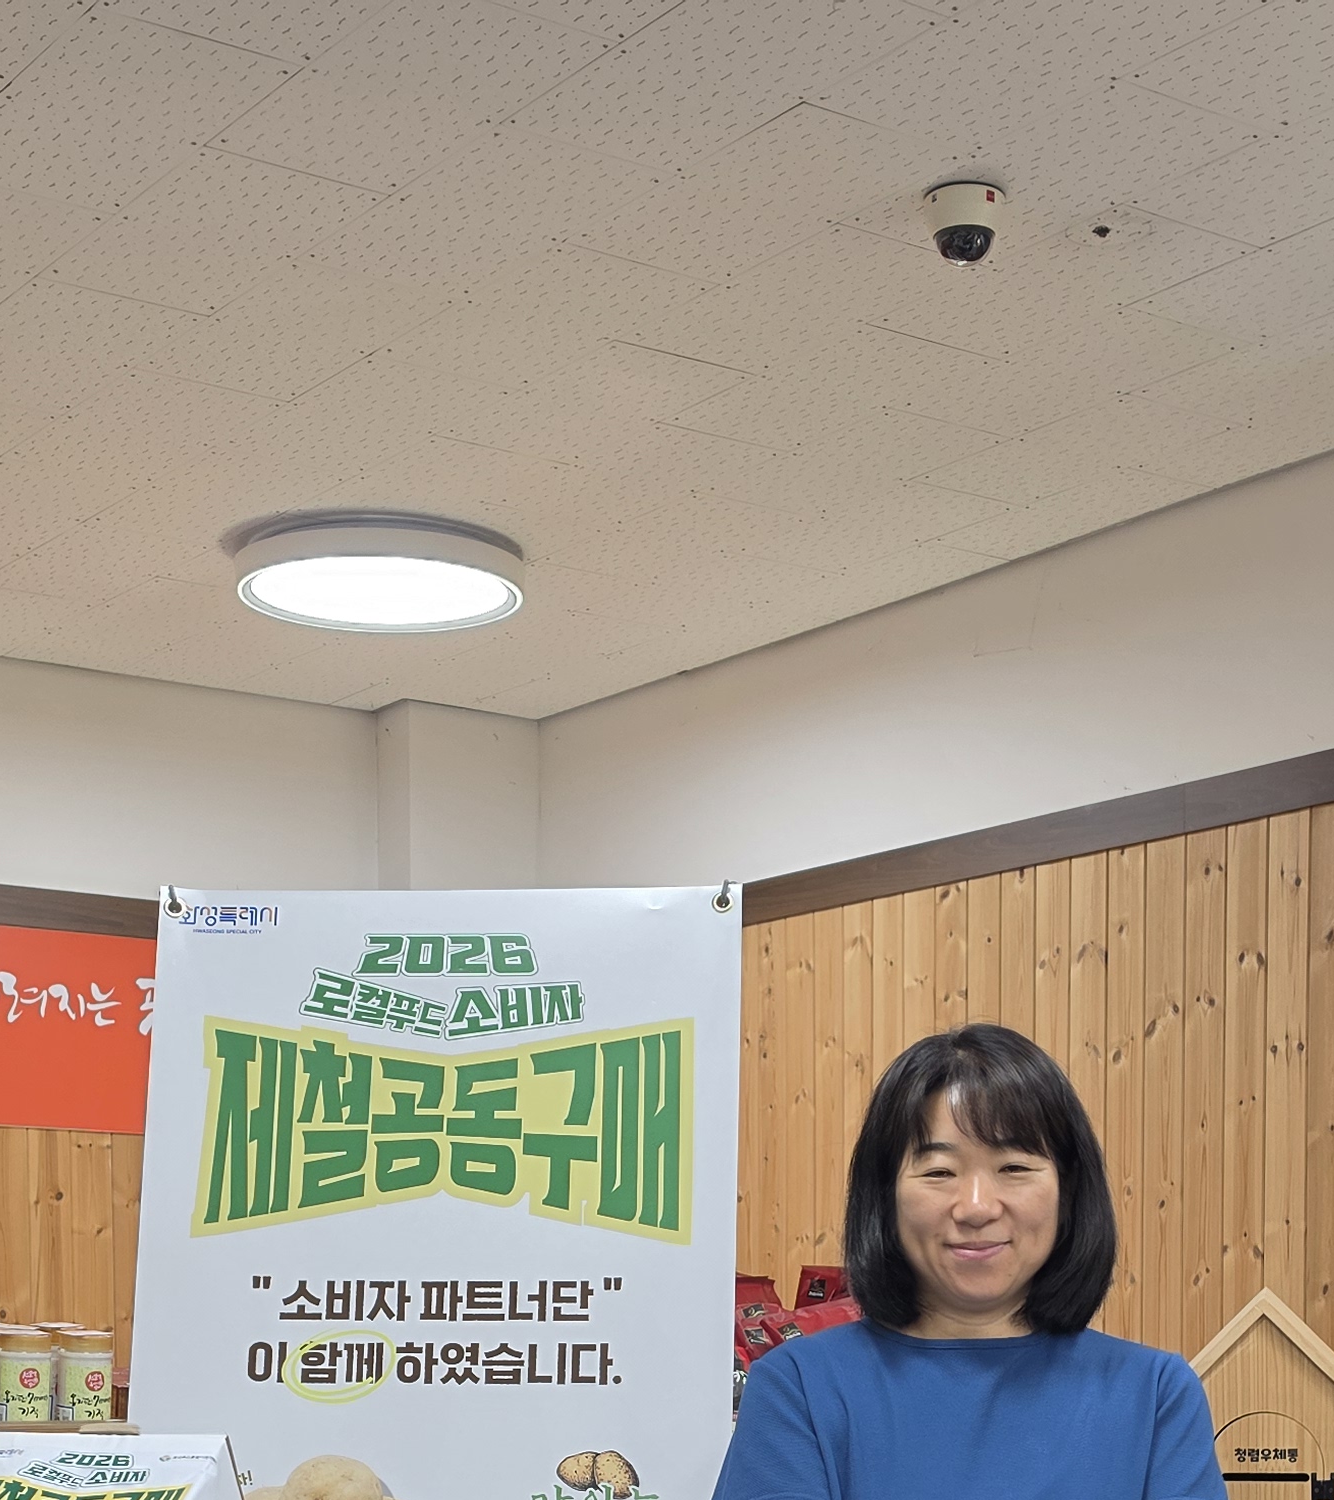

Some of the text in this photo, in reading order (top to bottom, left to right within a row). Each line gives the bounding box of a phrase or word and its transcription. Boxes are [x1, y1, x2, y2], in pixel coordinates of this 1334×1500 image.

[361, 935, 536, 974] 2026
[305, 970, 584, 1038] 로컬푸드 소비자
[204, 1028, 682, 1232] 제철공동구매
[247, 1340, 623, 1385] 이 함께 하였습니다.
[55, 1453, 131, 1466] 2026
[1235, 1448, 1298, 1462] 청렴우체통
[25, 1463, 147, 1488] 로컬푸드 소비자
